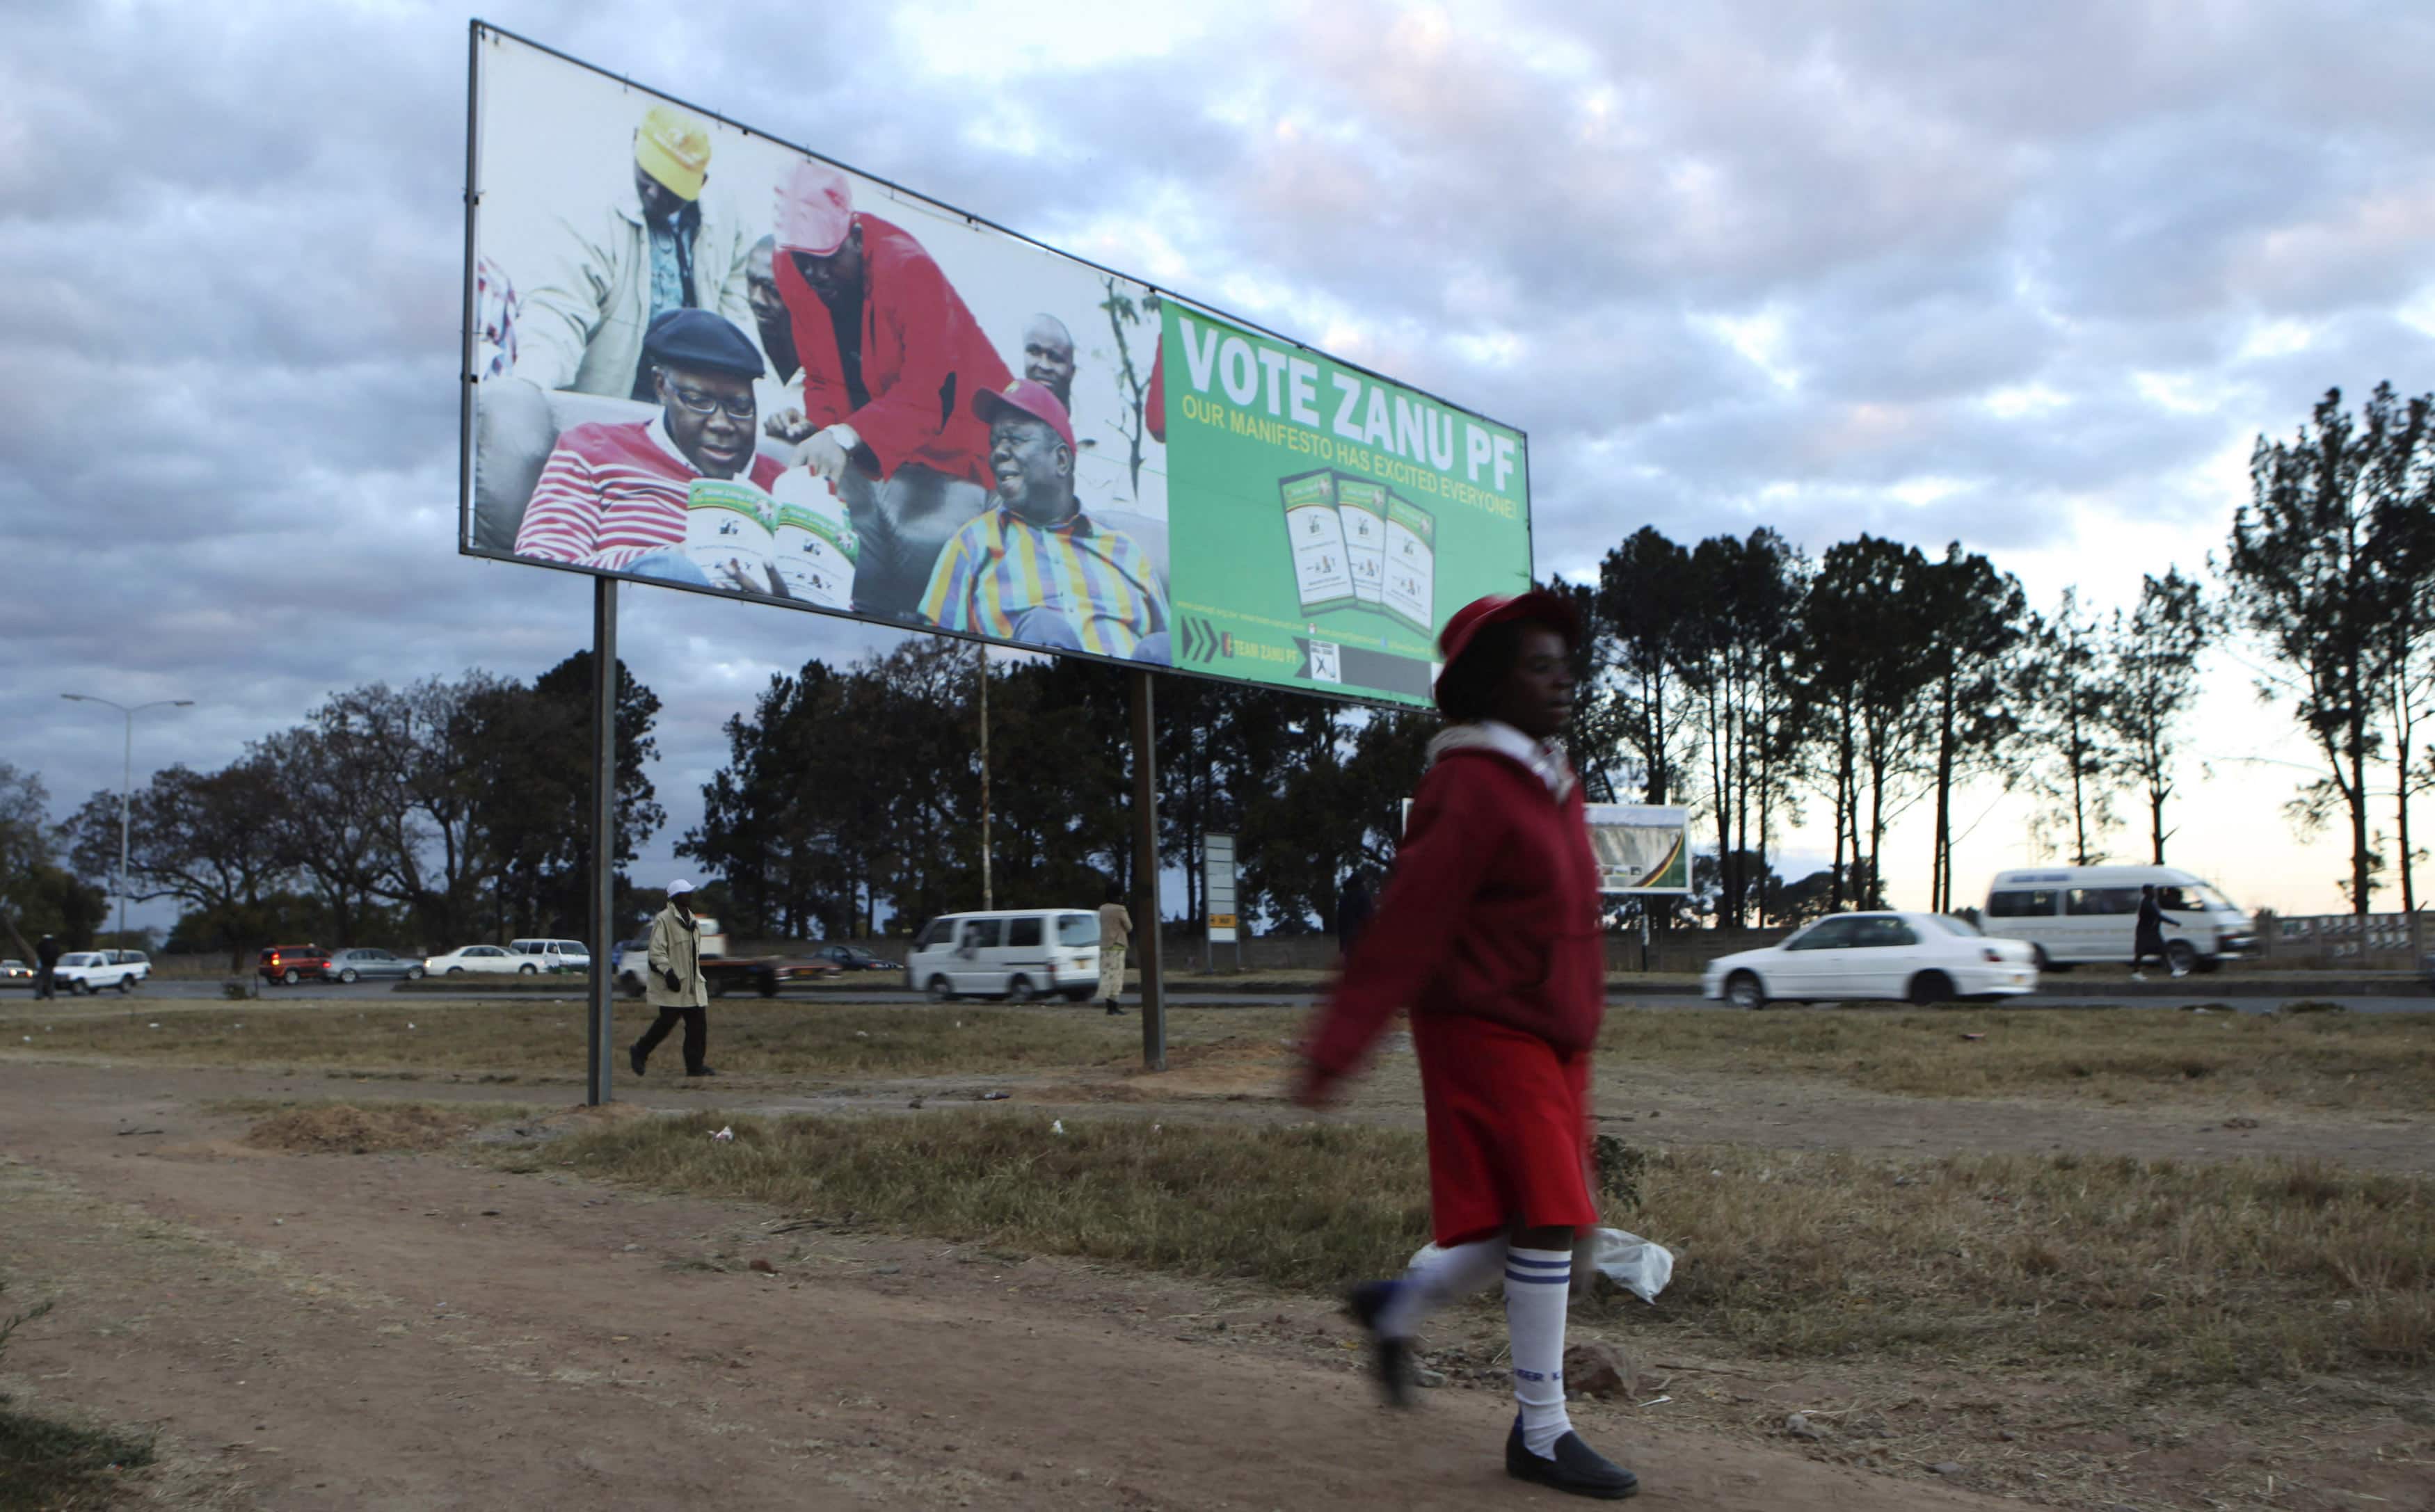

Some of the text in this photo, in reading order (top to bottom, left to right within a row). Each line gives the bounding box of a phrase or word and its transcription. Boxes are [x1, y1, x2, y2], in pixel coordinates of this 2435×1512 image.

[1179, 316, 1515, 491] VOTE ZANU PF
[1183, 394, 1225, 428] OUR
[1229, 409, 1333, 459] MANIFESTO
[1336, 442, 1370, 472] HAS
[1374, 454, 1438, 493] EXCITED
[1441, 476, 1517, 520] EVERYONE!
[1234, 638, 1259, 657] TEAM
